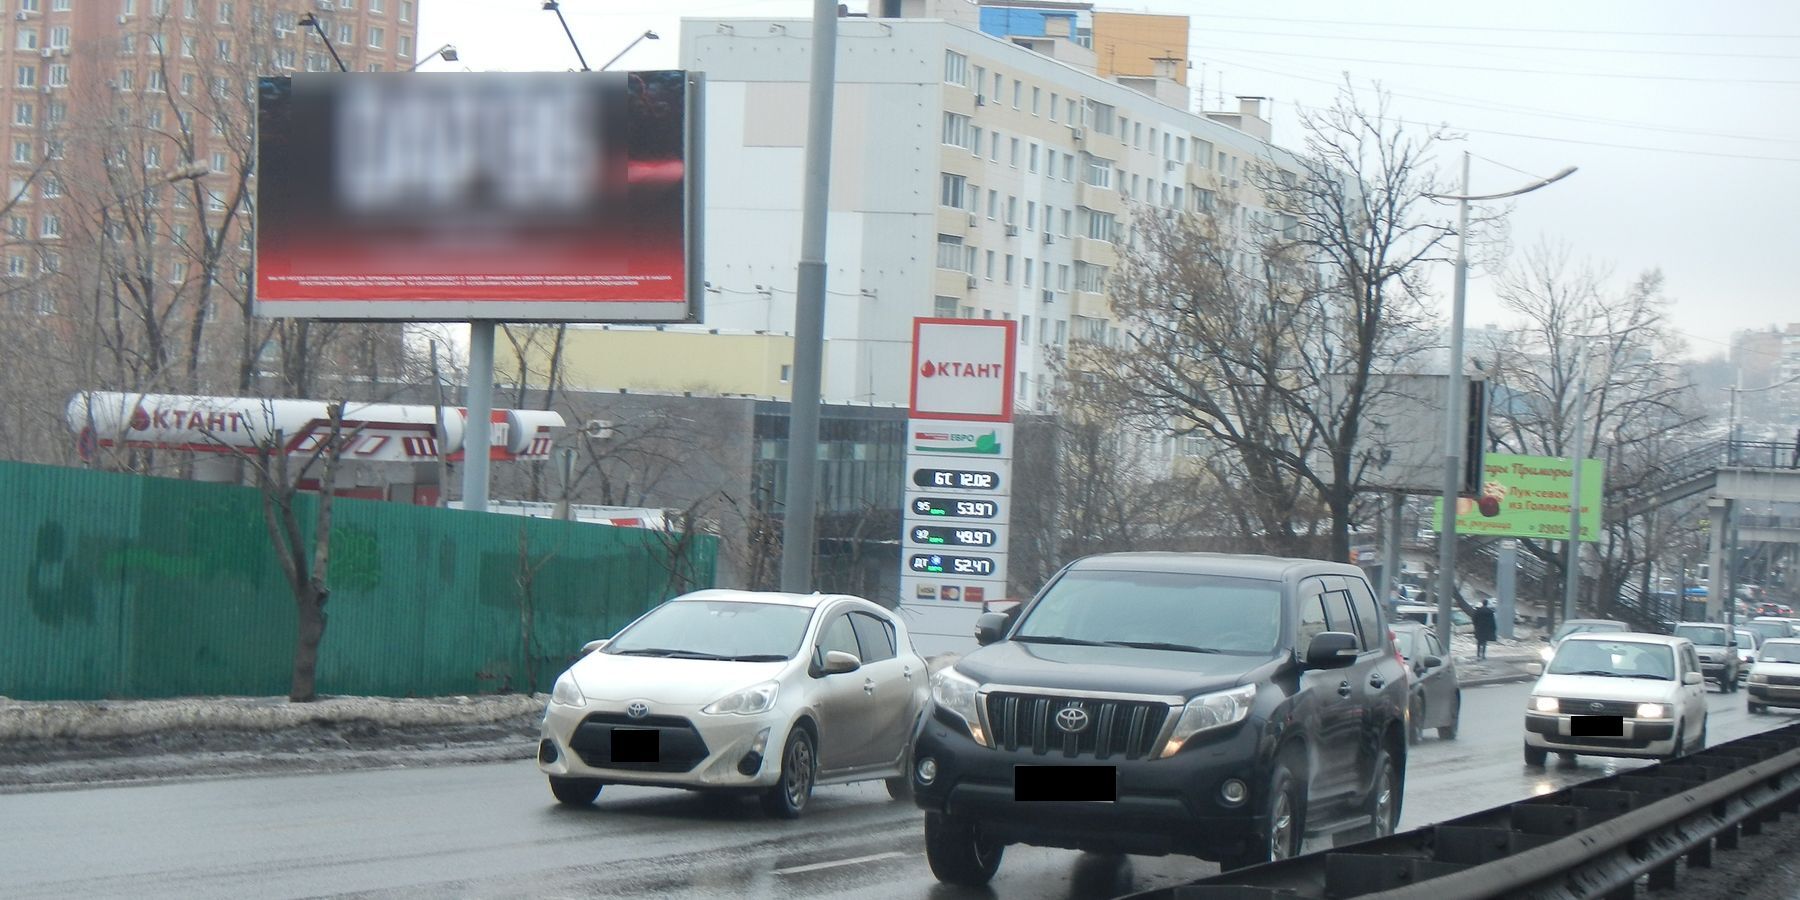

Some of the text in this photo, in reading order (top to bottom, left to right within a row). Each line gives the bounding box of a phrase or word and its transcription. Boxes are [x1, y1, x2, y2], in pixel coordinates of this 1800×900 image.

[917, 501, 930, 511] 95
[957, 501, 993, 516] 53.97
[955, 530, 991, 545] 49.97
[913, 557, 929, 568] ДТ
[954, 558, 990, 573] 52.47
